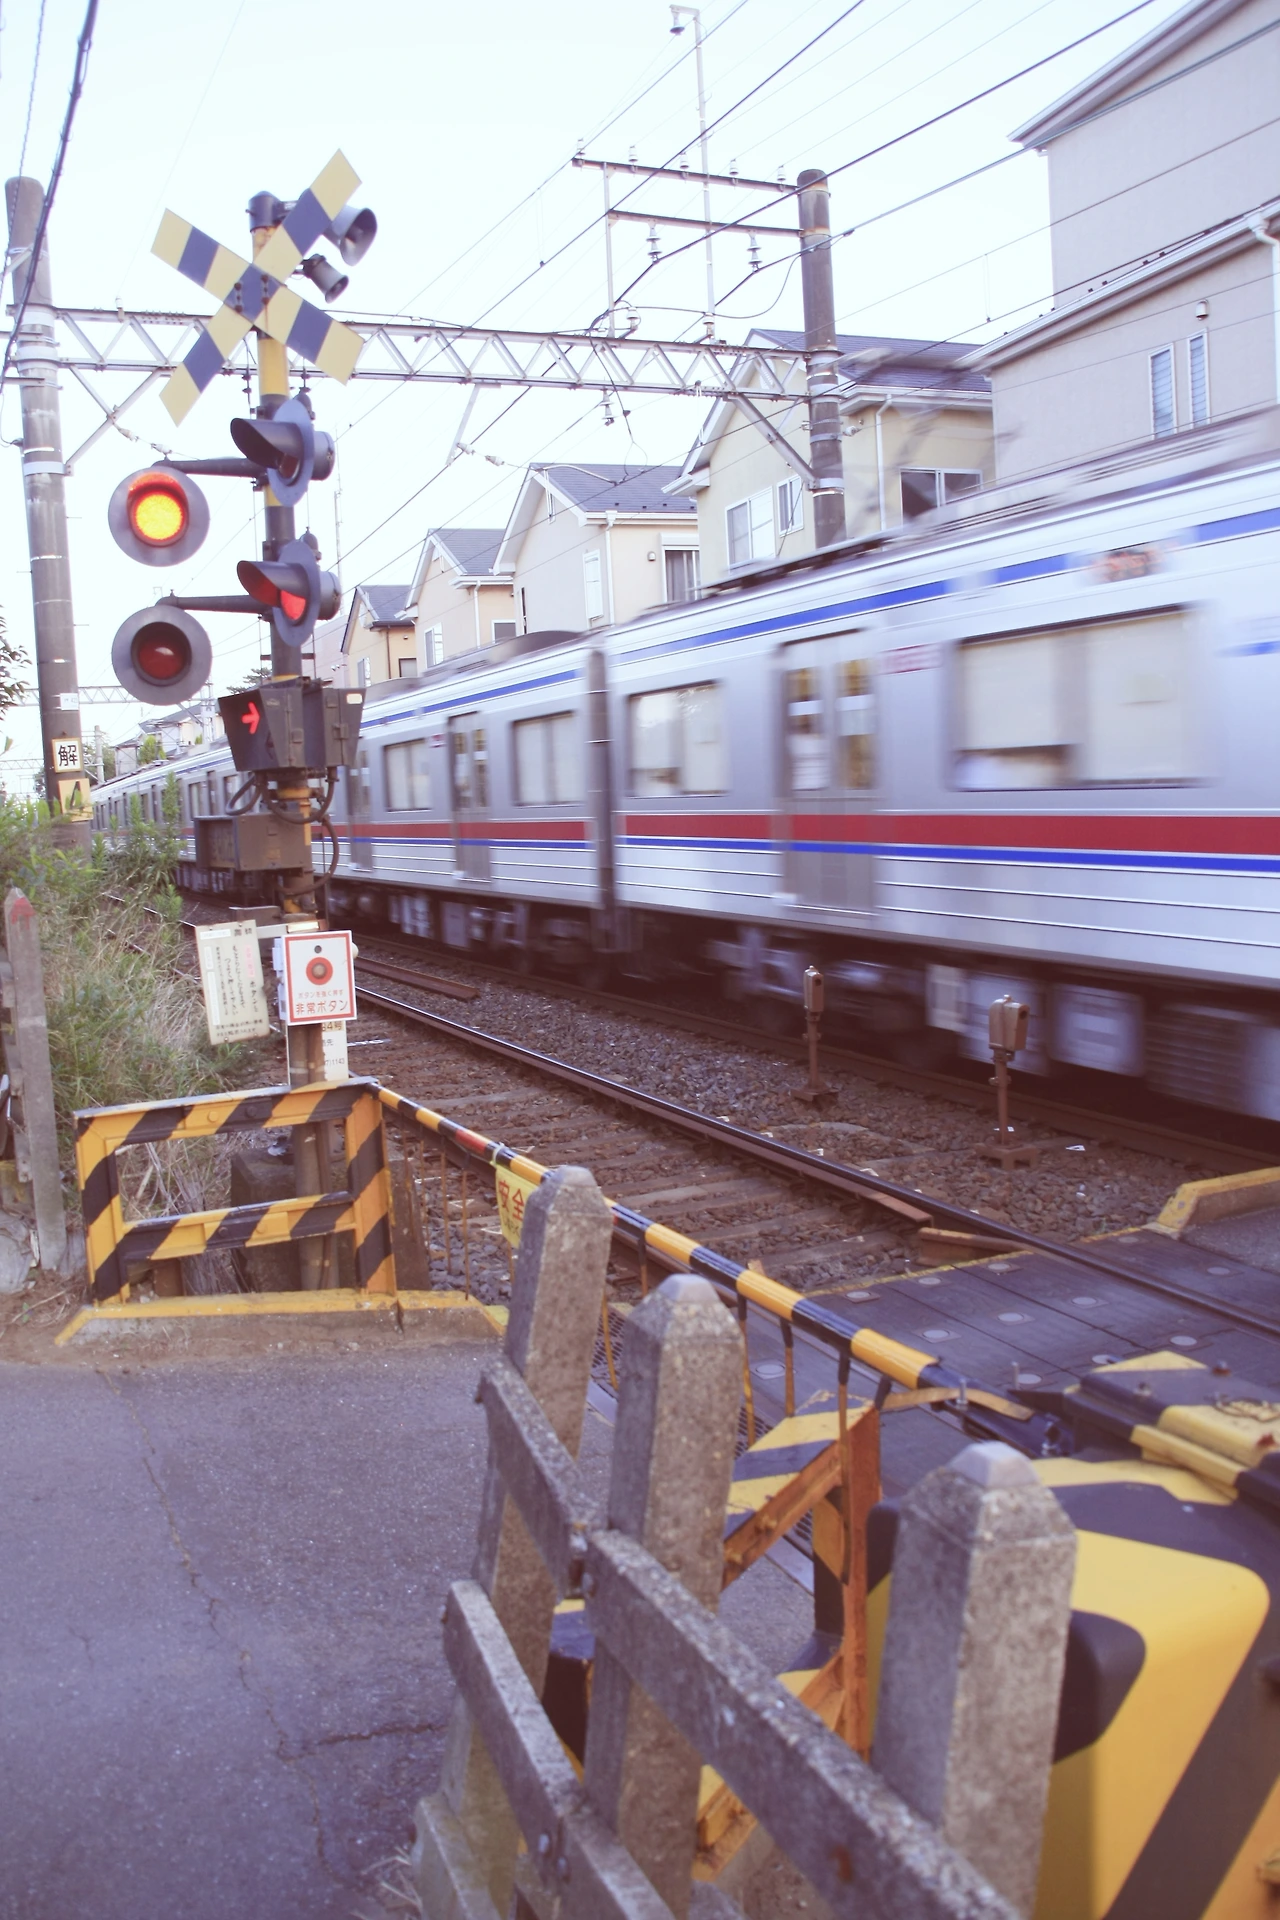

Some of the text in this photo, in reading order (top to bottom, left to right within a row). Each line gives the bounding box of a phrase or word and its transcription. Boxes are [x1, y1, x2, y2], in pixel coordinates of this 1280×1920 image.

[58, 744, 78, 767] 解
[296, 1000, 348, 1014] 非常ボタン
